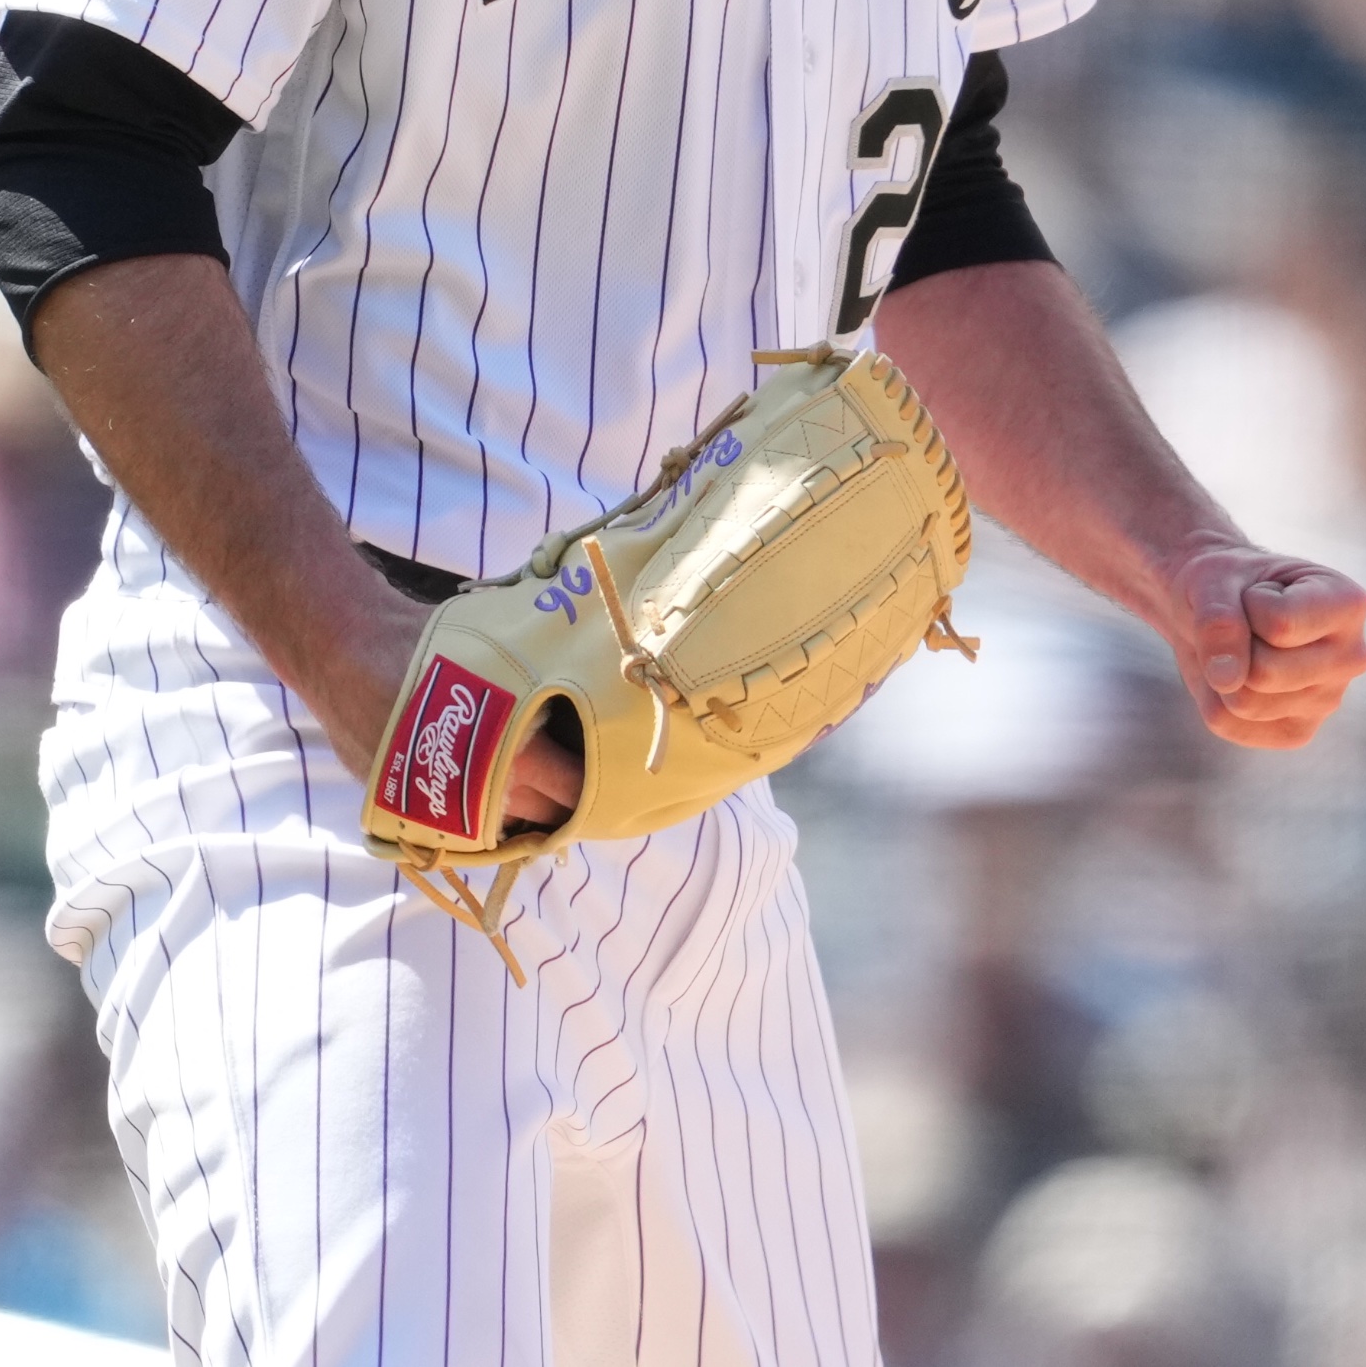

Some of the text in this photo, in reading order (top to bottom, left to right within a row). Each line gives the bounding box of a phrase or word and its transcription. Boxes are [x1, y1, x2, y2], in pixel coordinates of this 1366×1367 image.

[827, 76, 949, 346] 2
[384, 751, 406, 804] Est. 1887
[415, 683, 477, 819] Rawlings
